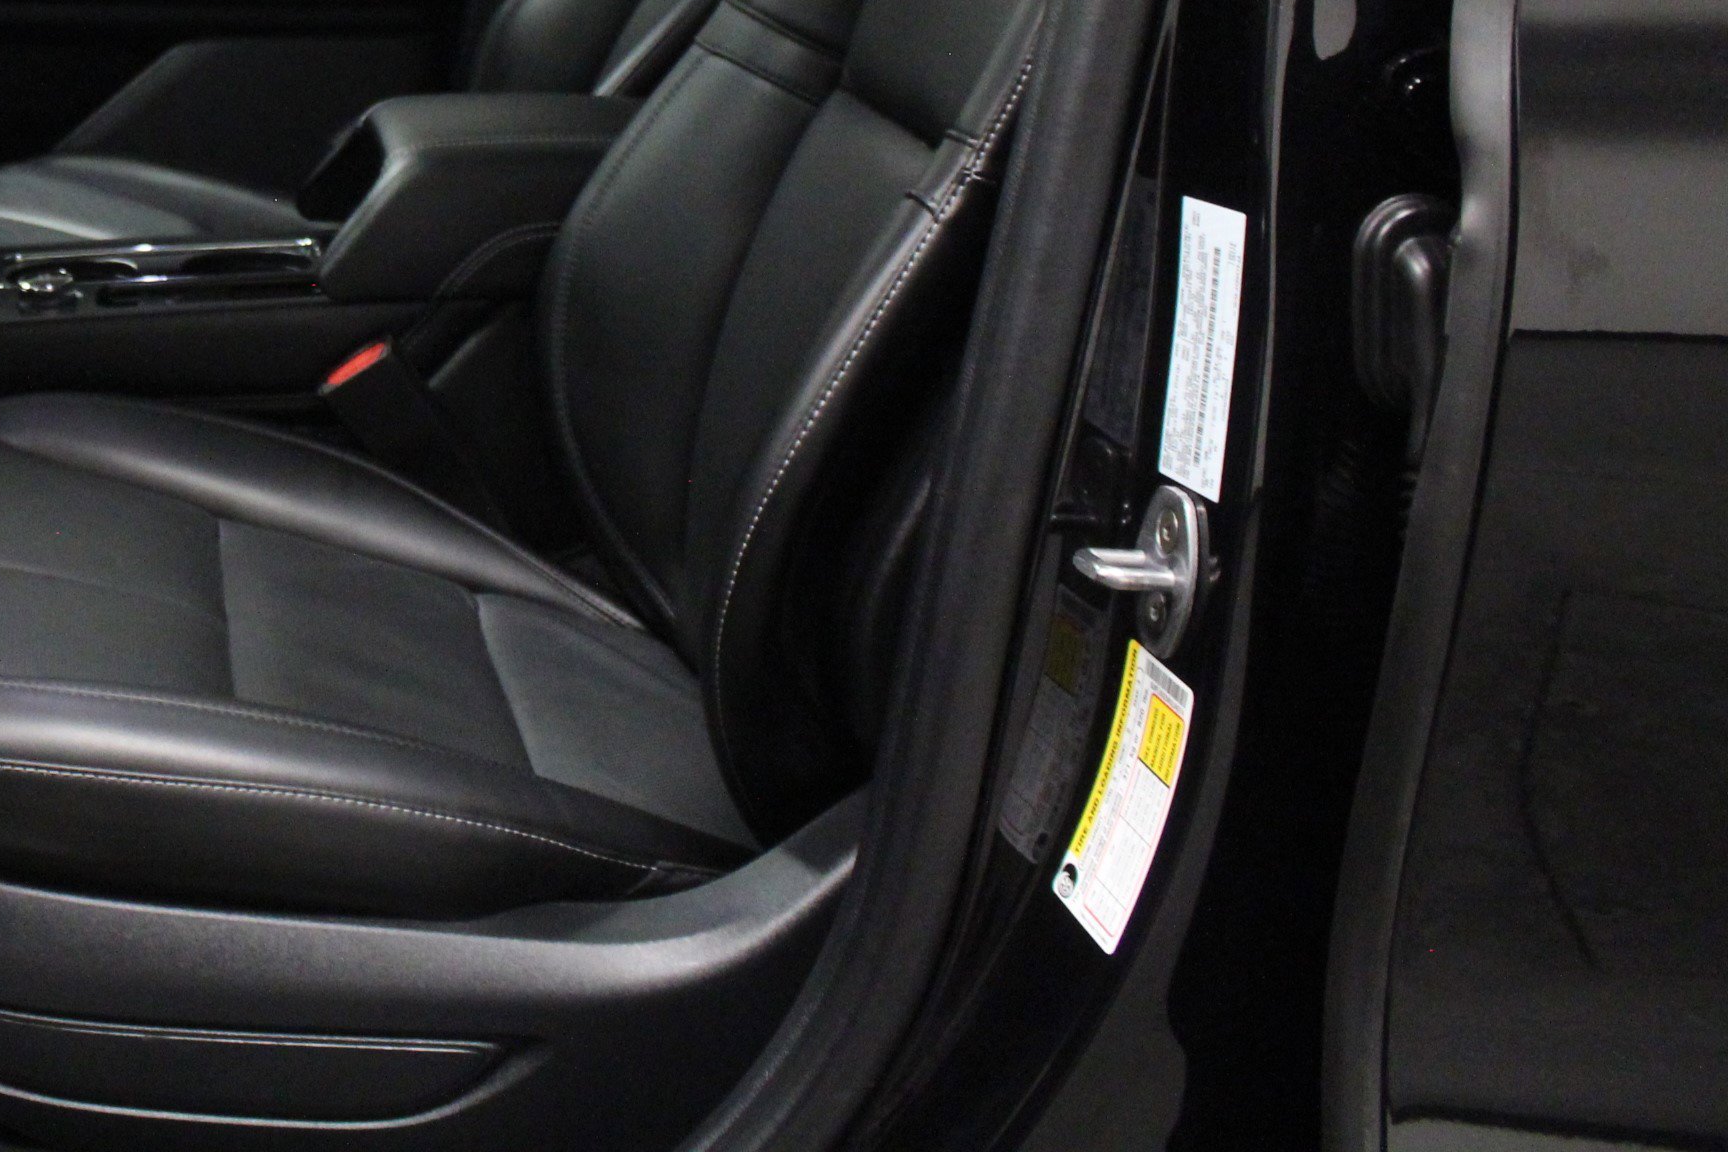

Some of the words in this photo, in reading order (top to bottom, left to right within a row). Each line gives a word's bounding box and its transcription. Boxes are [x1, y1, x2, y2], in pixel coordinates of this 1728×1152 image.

[1074, 826, 1089, 853] TIRE
[1087, 796, 1100, 824] AND
[1097, 740, 1119, 796] LOADING
[1115, 648, 1139, 738] INFORMATION
